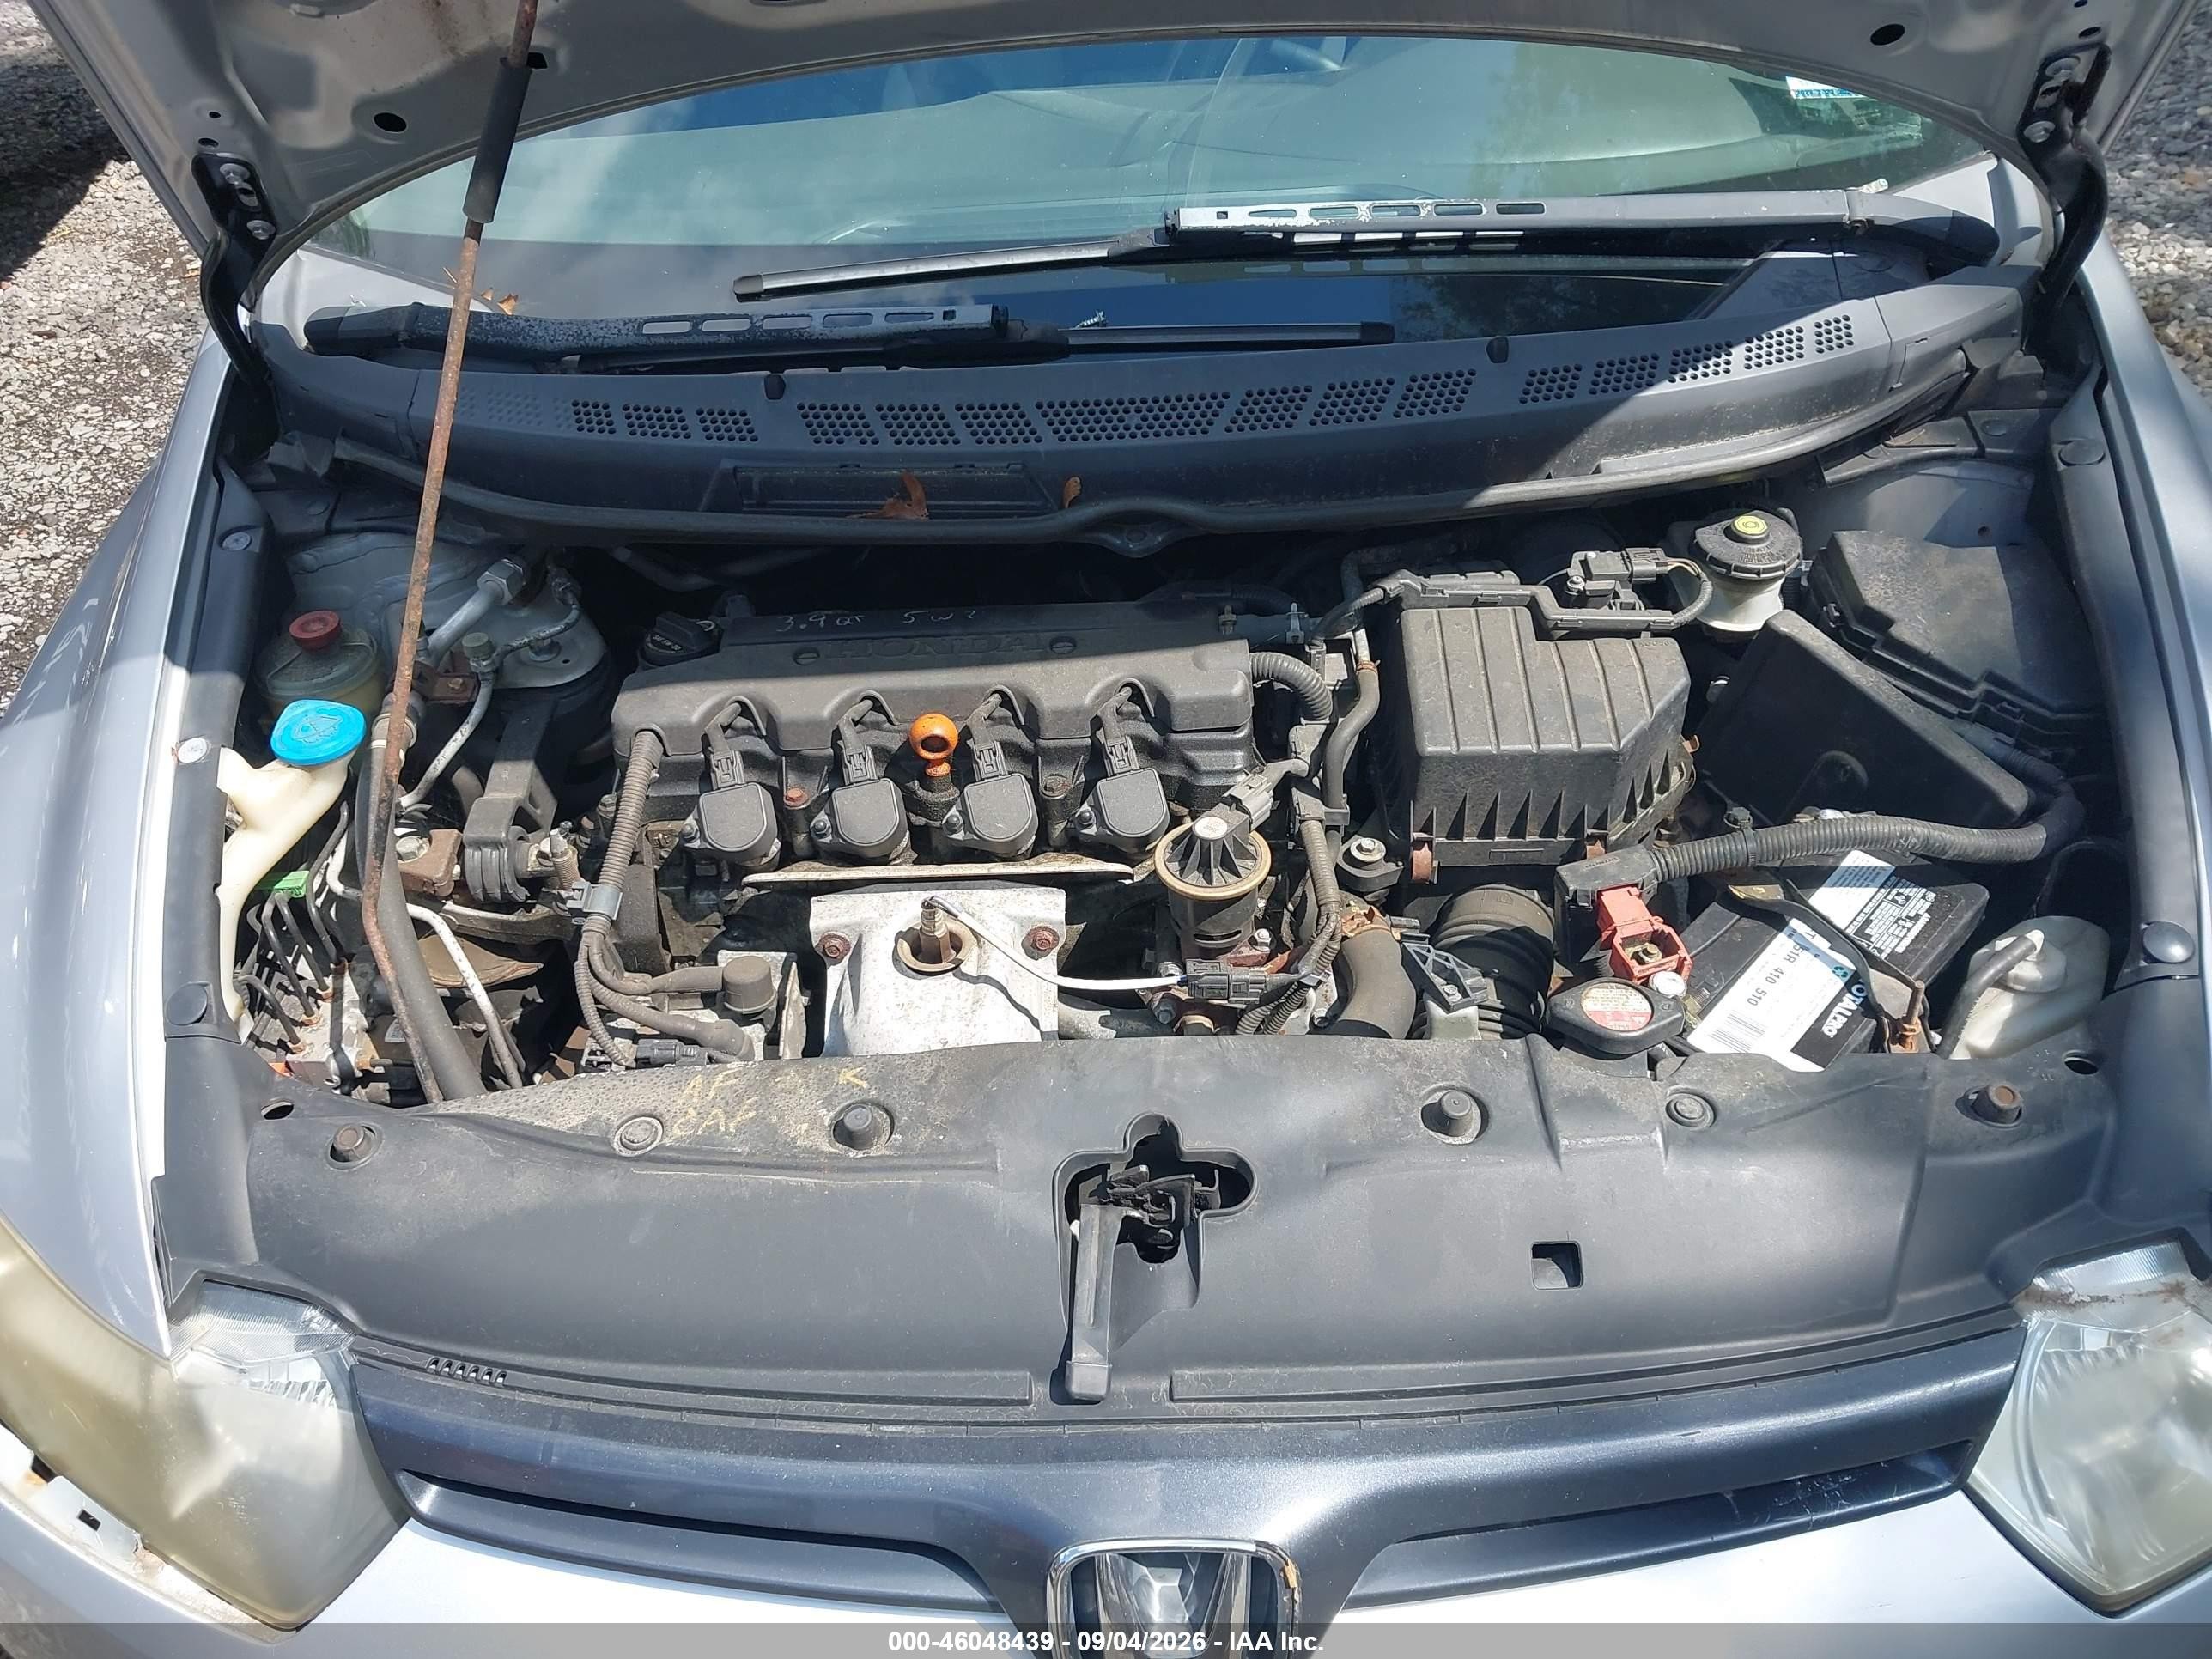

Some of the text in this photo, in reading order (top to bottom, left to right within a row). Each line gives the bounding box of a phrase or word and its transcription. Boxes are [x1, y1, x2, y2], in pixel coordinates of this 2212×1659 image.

[775, 612, 825, 632] 3.9
[821, 635, 1048, 660] HONDA
[1783, 944, 1804, 963] 51R
[1765, 967, 1784, 984] 410
[1747, 988, 1767, 1006] 510
[1820, 981, 1868, 1038] OTALPRO
